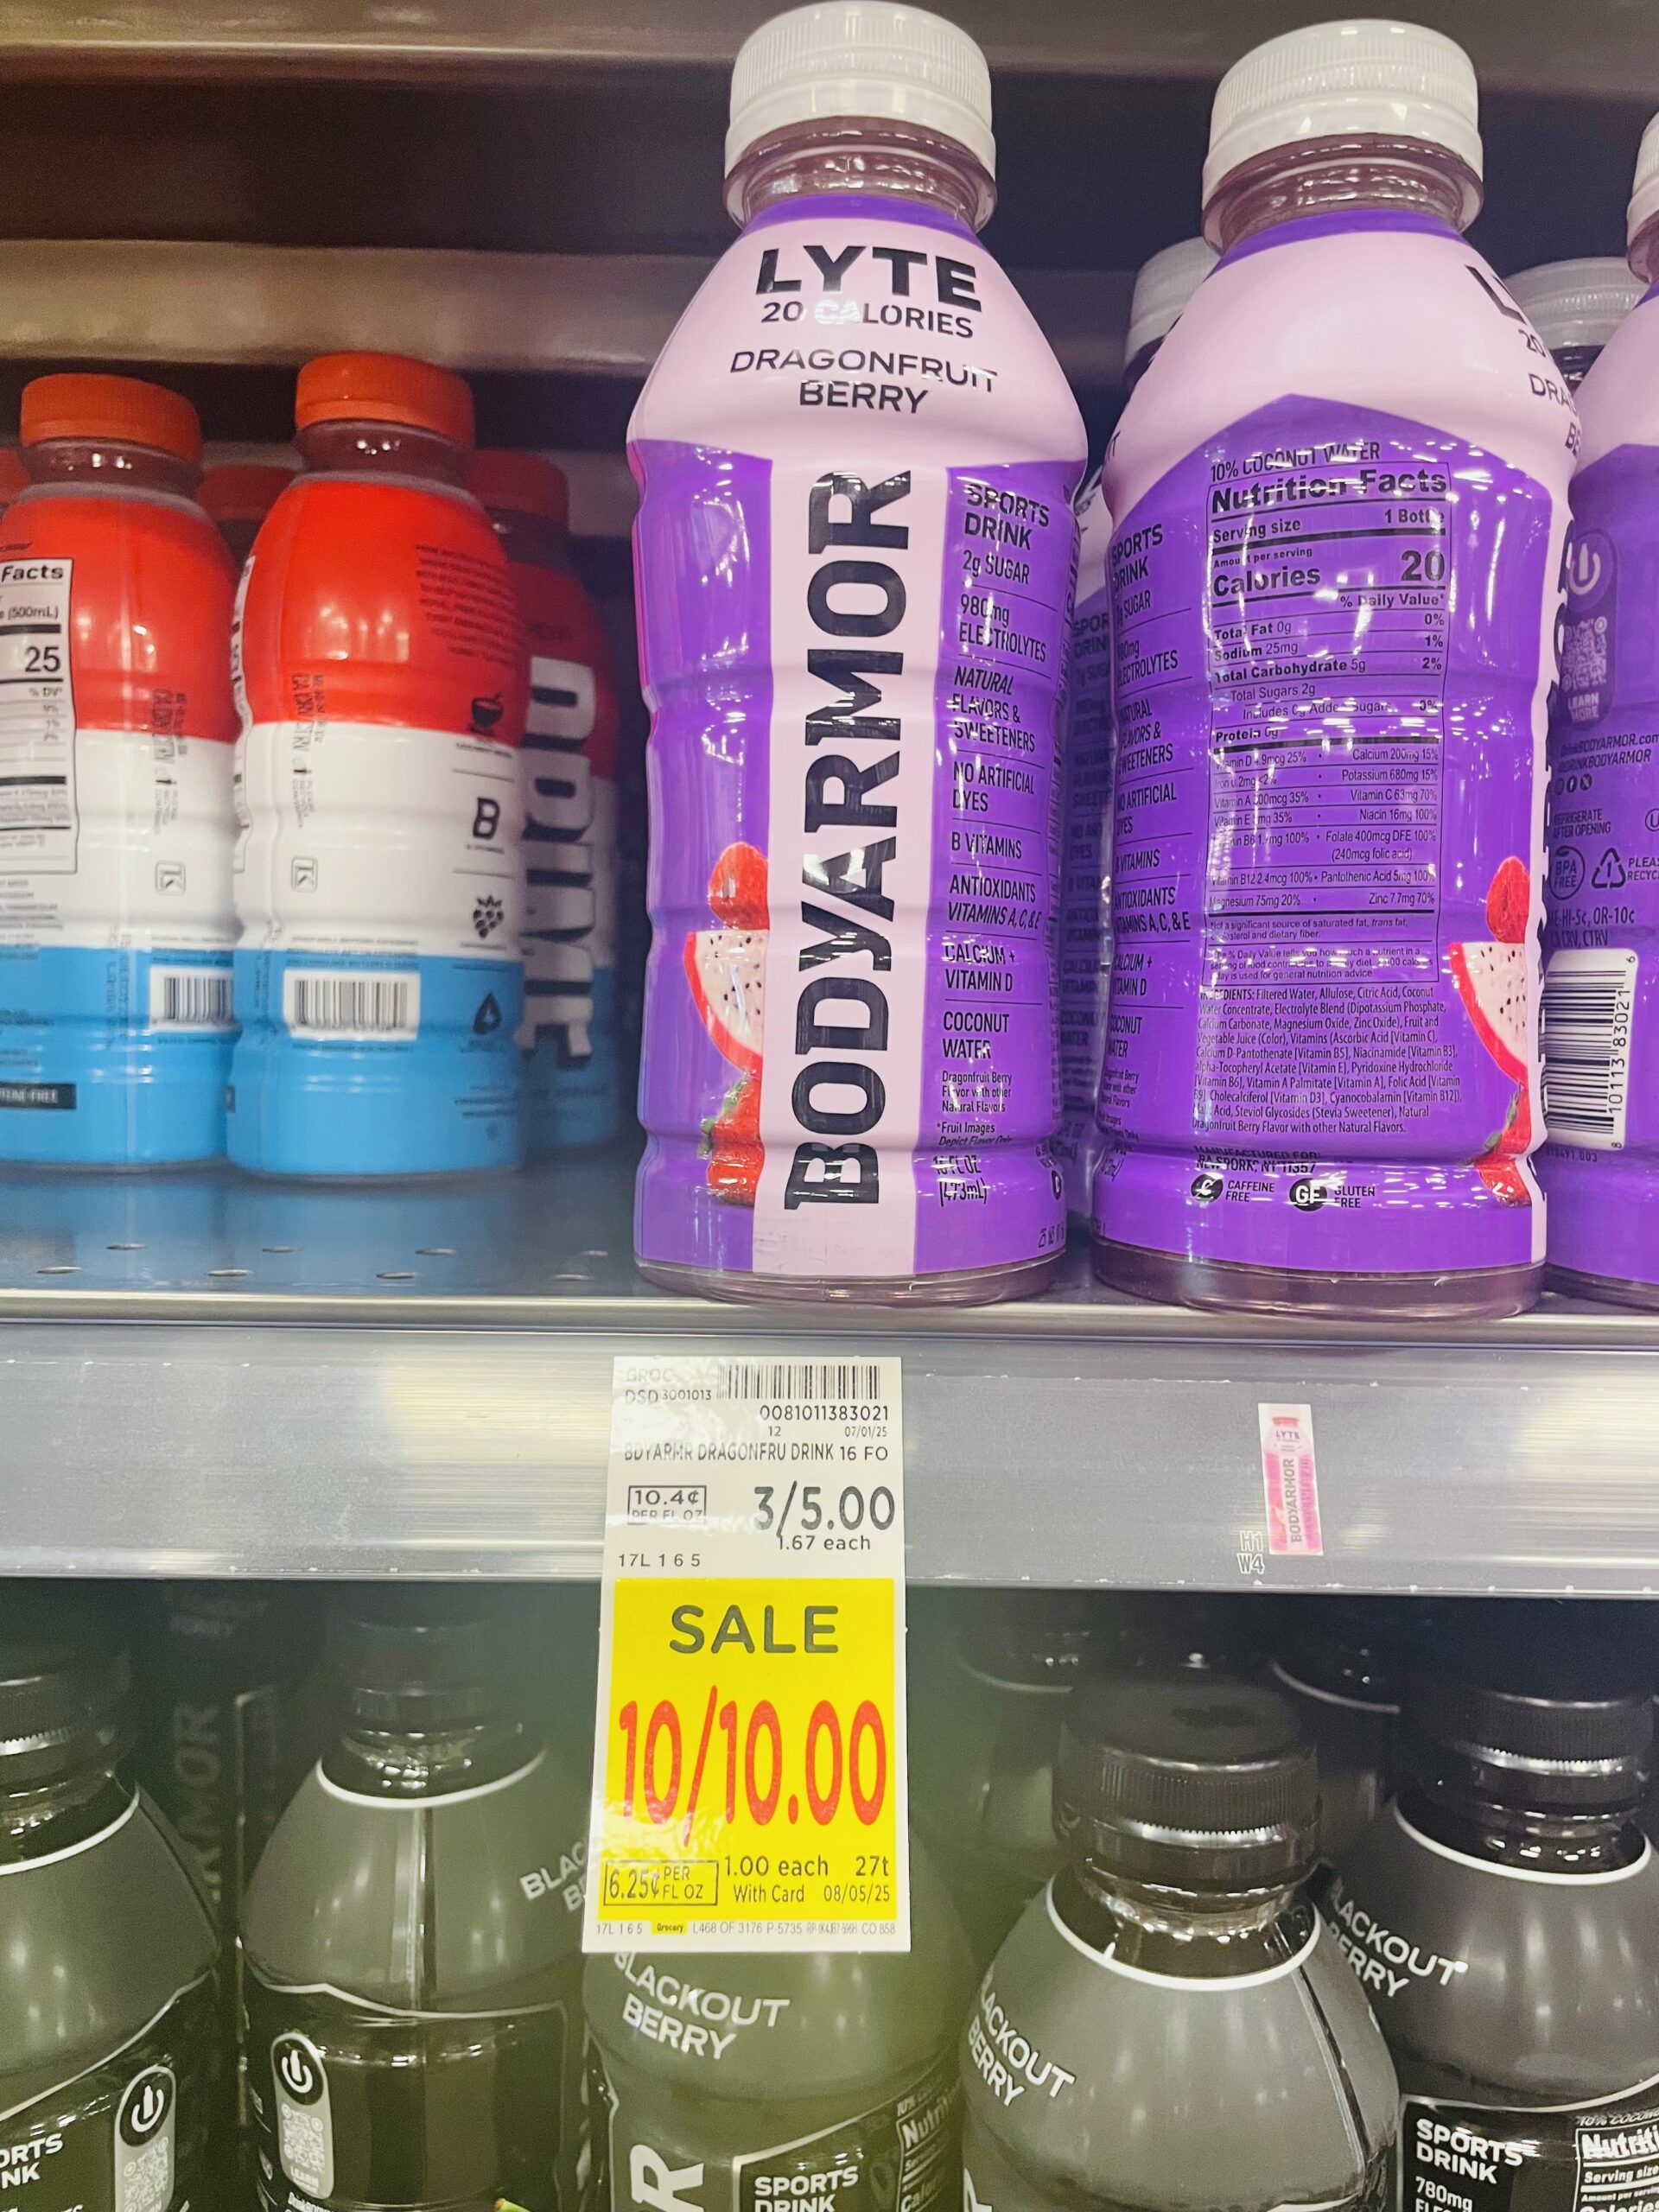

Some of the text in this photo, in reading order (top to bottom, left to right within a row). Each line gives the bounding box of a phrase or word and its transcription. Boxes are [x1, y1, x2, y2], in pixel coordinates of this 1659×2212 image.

[755, 244, 982, 313] LYTE
[760, 300, 974, 339] 20 CALORIES
[730, 348, 999, 393] DRAGONFRUIT
[799, 380, 929, 413] BERRY
[1211, 461, 1239, 482] 10%
[1211, 468, 1447, 514] Nutrition Facts
[966, 483, 1050, 528] SPORTS
[1384, 511, 1392, 523] 1
[964, 512, 1033, 551] DRINK
[1213, 518, 1300, 545] Serving size
[2, 564, 64, 583] Facts
[963, 550, 1030, 585] 2g SUGAR
[1212, 550, 1446, 597] Calories 20
[1251, 621, 1292, 637] Fat 0g
[1424, 613, 1445, 626] 0%
[958, 622, 1047, 664] ELECTROLYTES
[1214, 634, 1444, 662] Sodium 25mg 1%
[25, 646, 61, 673] 25
[1251, 660, 1347, 678] Carbohydrate
[1351, 658, 1366, 672] 5g
[1421, 657, 1442, 670] 2%
[954, 665, 1014, 696] NATURAL
[1259, 685, 1298, 701] Sugars
[1301, 683, 1316, 697] 2g
[952, 693, 1021, 724] FLAVORS &
[953, 720, 1035, 753] SWEETENERS
[953, 761, 1035, 795] NO ARTIFICIAL
[1342, 769, 1439, 783] Potassium 680mg 15%
[952, 788, 988, 812] DYES
[1360, 809, 1387, 820] Niacin
[1389, 808, 1413, 822] 16mg
[784, 469, 912, 1211] BODYARMOR
[951, 831, 1022, 859] B VITAMINS
[949, 874, 1036, 903] ANTIOXIDANTS
[948, 901, 1008, 929] VITAMINS
[945, 943, 1016, 965] CALCIUM +
[945, 969, 1014, 992] VITAMIN D
[1256, 986, 1433, 1001] Filtered Water, Allulose, Citric Acid, Coconut
[943, 1010, 1009, 1033] COCONUT
[1223, 1001, 1446, 1018] Concentrate, Electrolyte Blend (Dipotassium Phosphate,
[1612, 989, 1631, 1047] 83021
[942, 1038, 992, 1059] WATER
[942, 1070, 1013, 1087] Dragonfruit Berry
[1608, 1058, 1626, 1114] 10113
[964, 1122, 995, 1135] Images
[1225, 1191, 1251, 1204] FREE
[1227, 1179, 1275, 1193] CAFFEINE
[625, 1389, 712, 1404] DSD 3001013
[759, 1404, 889, 1422] 0081011383021
[768, 1426, 887, 1440] 12 07/01/25
[697, 1443, 786, 1461] DRAGONFRU
[791, 1443, 834, 1461] DRINK
[839, 1446, 857, 1461] 16
[864, 1446, 889, 1461] FO
[634, 1480, 895, 1538] 10.4¢ 3/5.00
[1283, 1458, 1303, 1543] BODYARMOR
[779, 1535, 871, 1551] 1.67 each
[618, 1554, 702, 1567] 17L 6 5
[669, 1604, 839, 1654] SALE
[619, 1684, 887, 1847] 10/10.00
[608, 1868, 660, 1900] 6.25¢
[664, 1866, 690, 1881] PER
[724, 1855, 769, 1878] 1.00
[778, 1854, 829, 1877] each
[855, 1855, 889, 1877] 27t
[663, 1884, 890, 1904] FL OZ With Card 08/05/25
[657, 1923, 683, 1934] Grocery
[692, 1923, 716, 1934] L468
[738, 1923, 763, 1934] 3176
[766, 1923, 802, 1935] P-5735
[861, 1923, 877, 1935] CO
[621, 1993, 737, 2061] BERRY
[968, 2013, 1026, 2107] BERRY
[1415, 2118, 1524, 2167] SPORTS
[1415, 2141, 1498, 2184] DRINK
[1584, 2169, 1635, 2183] Serving
[754, 2165, 859, 2196] SPORTS
[1415, 2176, 1473, 2212] 780mg
